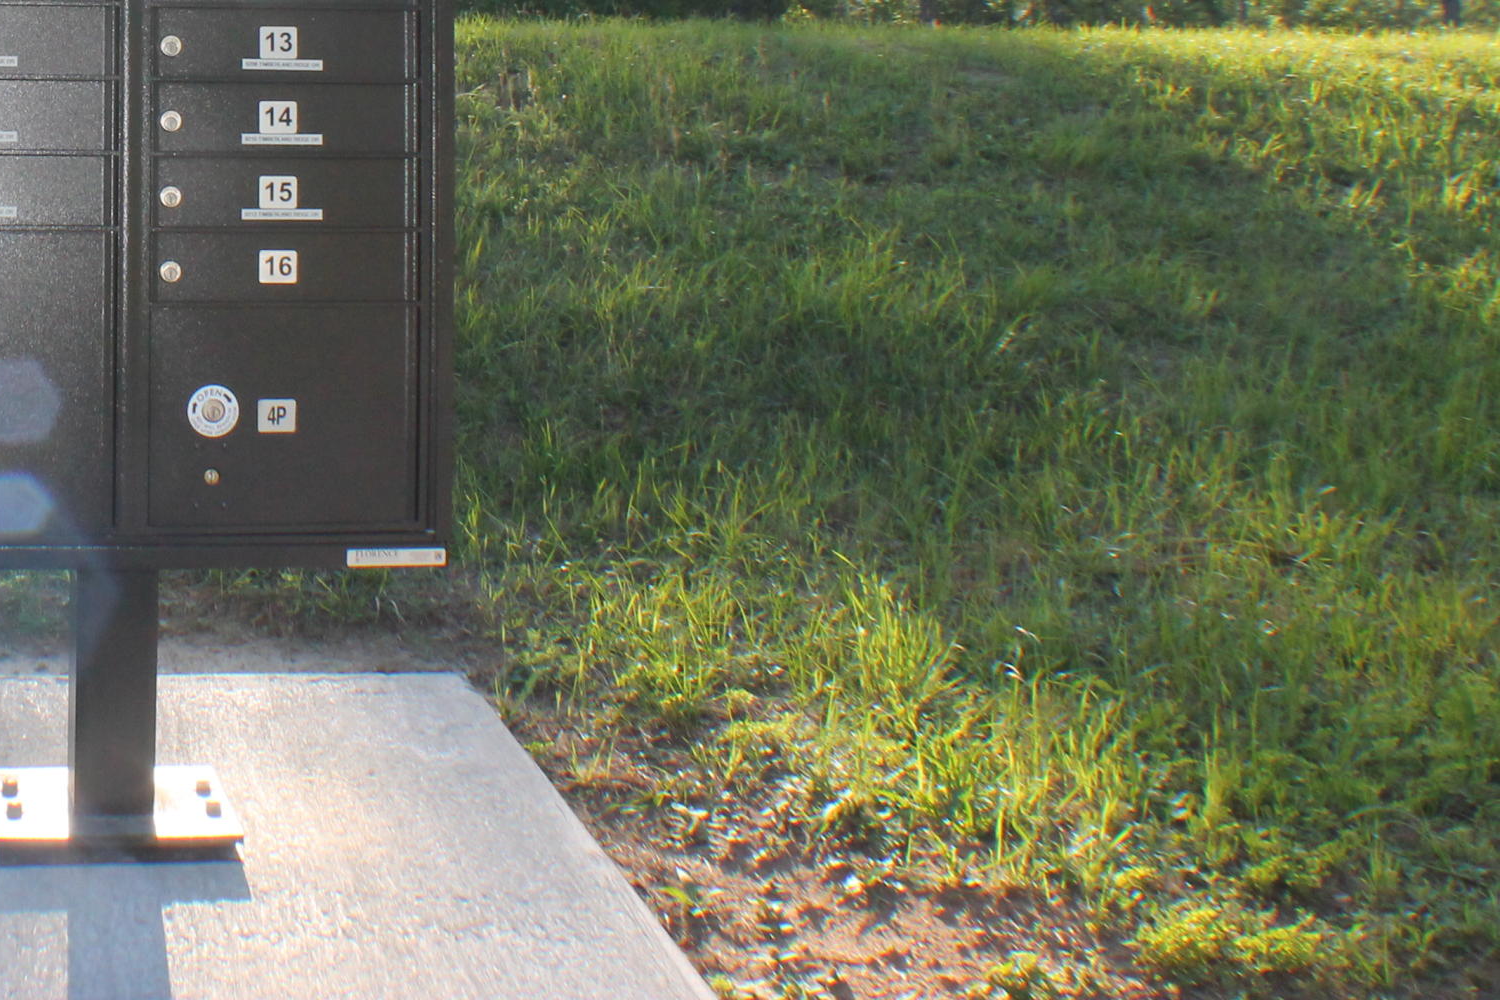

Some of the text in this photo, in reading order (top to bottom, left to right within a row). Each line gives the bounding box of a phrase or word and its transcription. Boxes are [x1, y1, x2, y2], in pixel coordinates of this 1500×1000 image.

[265, 32, 293, 53] 13
[265, 106, 293, 127] 14
[265, 181, 293, 202] 15
[265, 255, 293, 277] 16
[196, 388, 222, 402] OPEN
[267, 405, 287, 425] 4P
